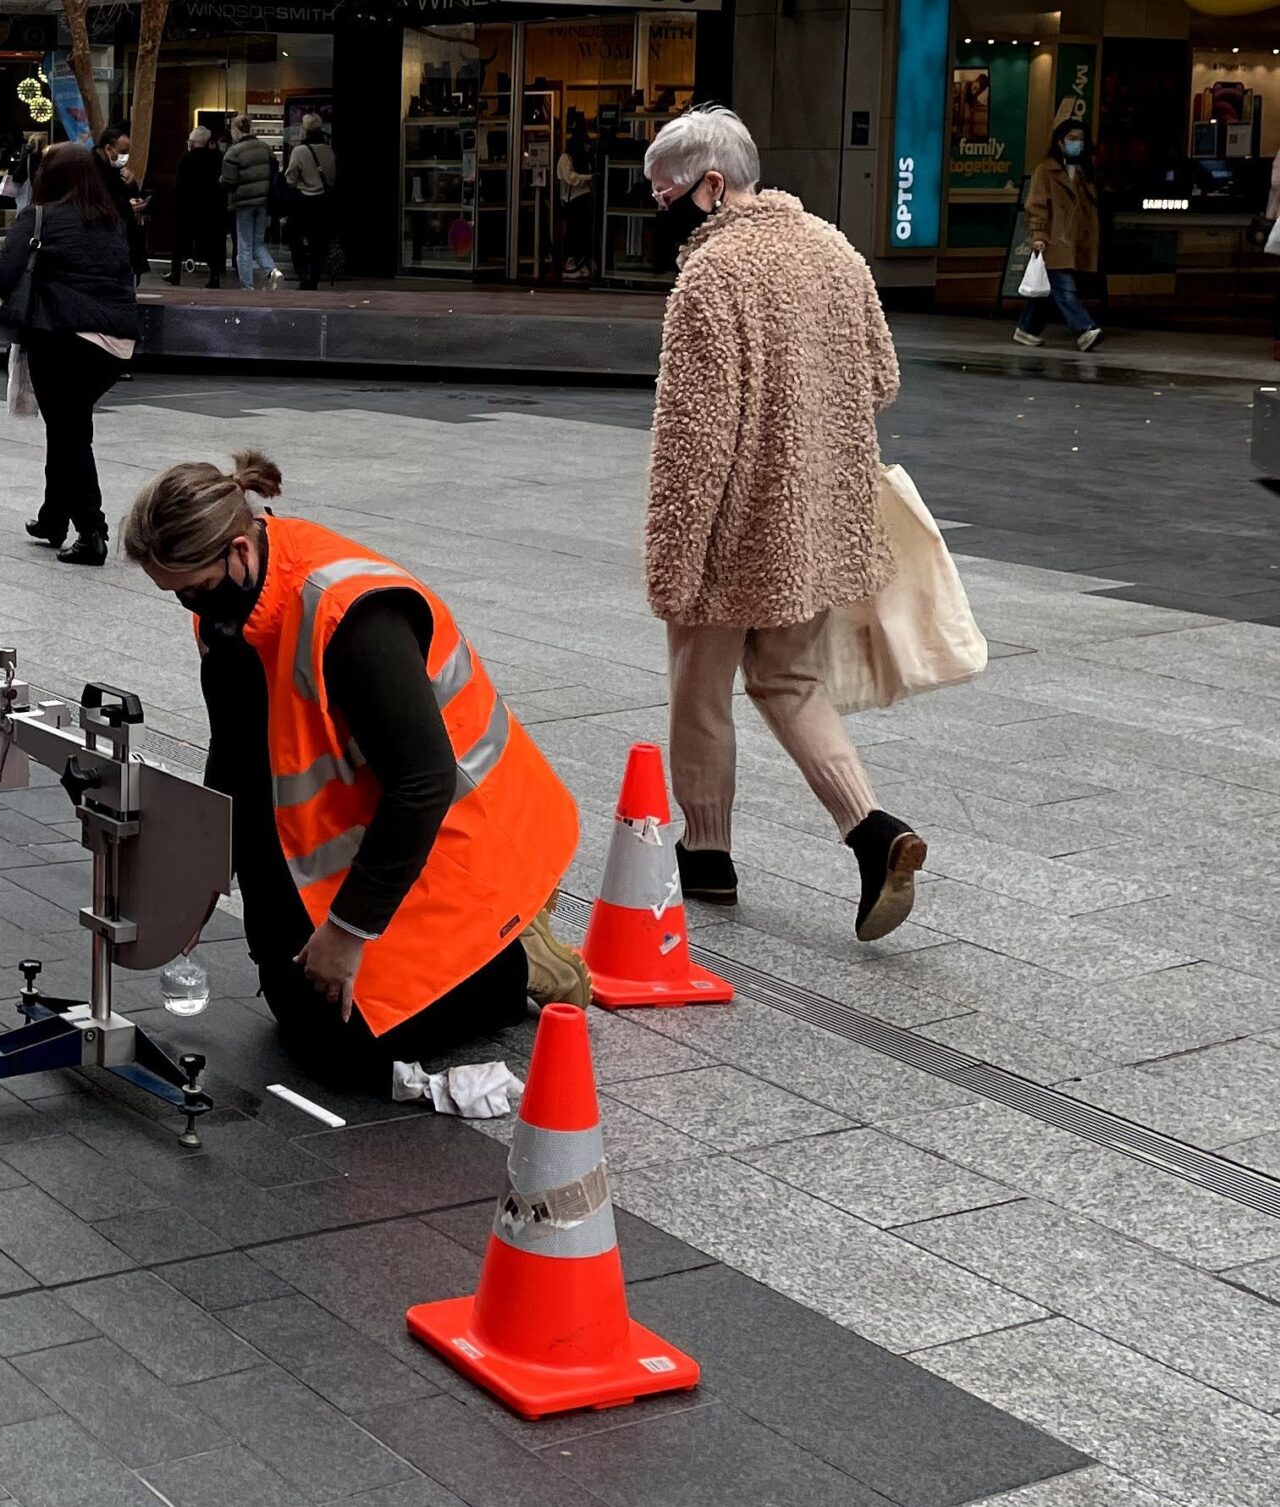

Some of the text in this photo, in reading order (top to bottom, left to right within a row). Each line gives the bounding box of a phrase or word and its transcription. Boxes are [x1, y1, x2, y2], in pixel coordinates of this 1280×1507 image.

[1071, 64, 1089, 97] My
[959, 137, 1006, 160] family
[895, 156, 914, 240] OPTUS
[1142, 198, 1189, 210] SAMSUNG
